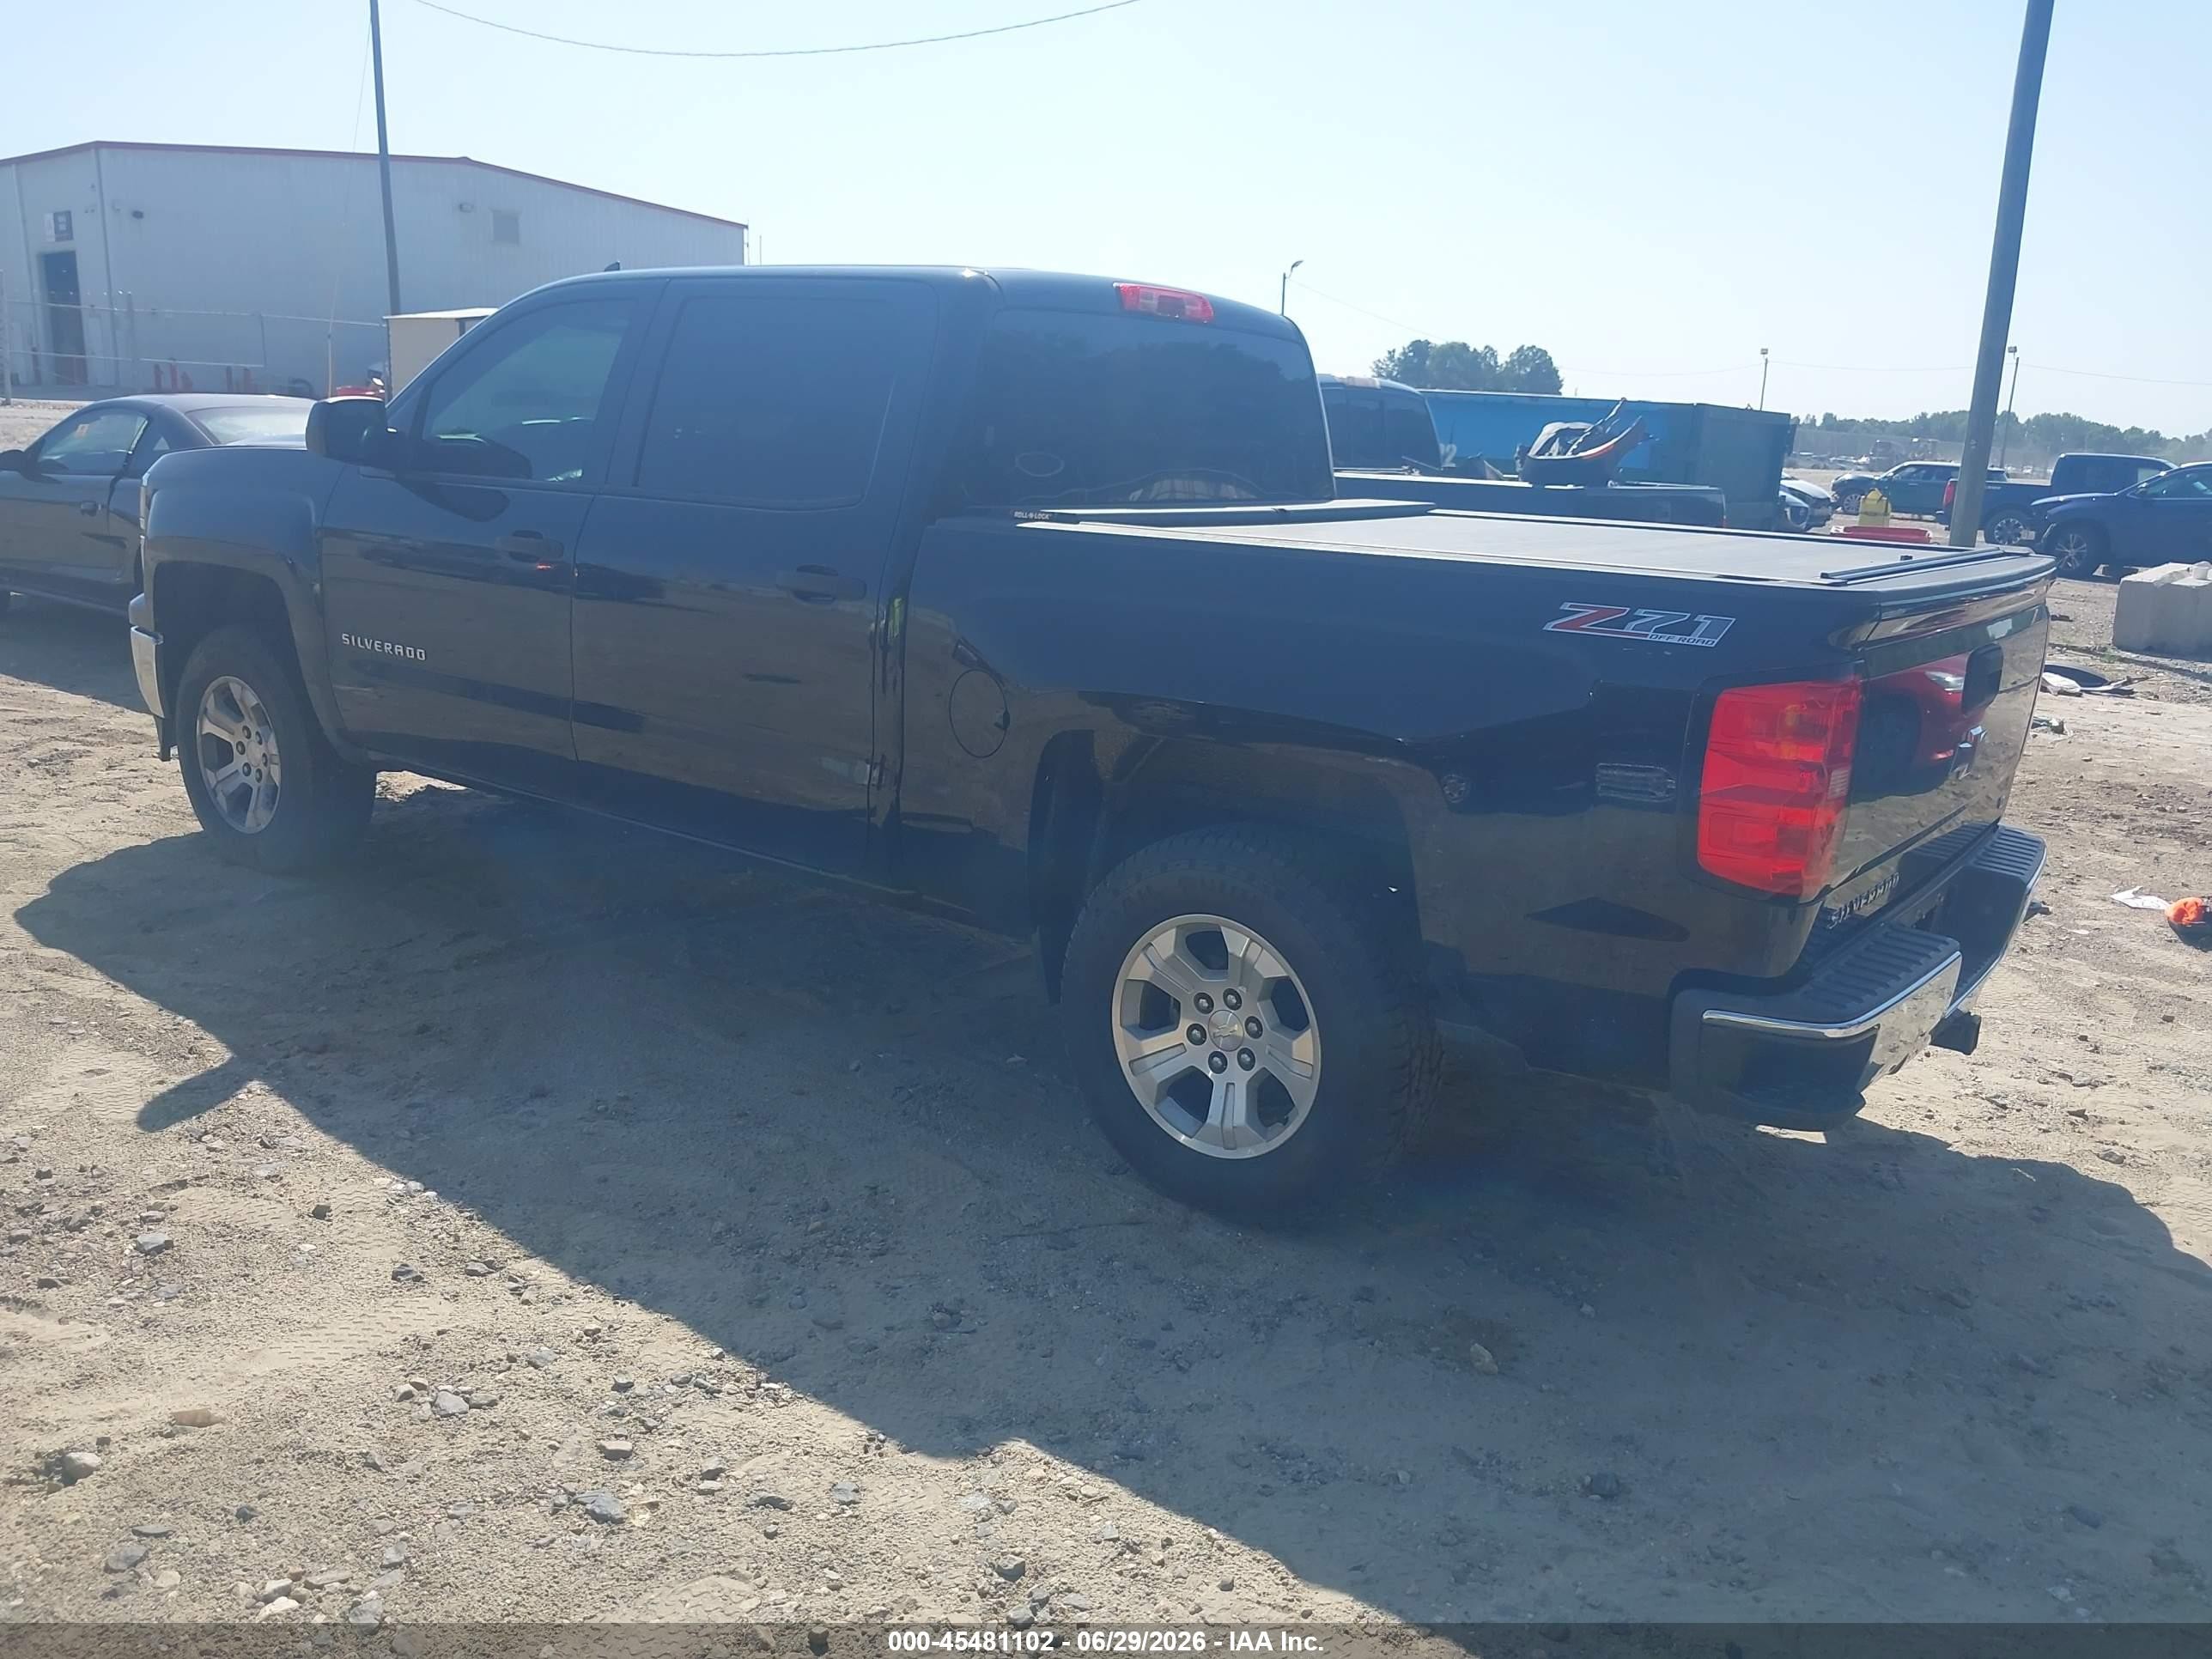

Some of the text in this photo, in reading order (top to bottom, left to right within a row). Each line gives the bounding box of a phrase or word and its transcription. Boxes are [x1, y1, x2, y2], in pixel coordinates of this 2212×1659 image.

[1542, 602, 1735, 644] Z71
[342, 633, 426, 660] SILVERADO
[1677, 636, 1716, 646] ROAD
